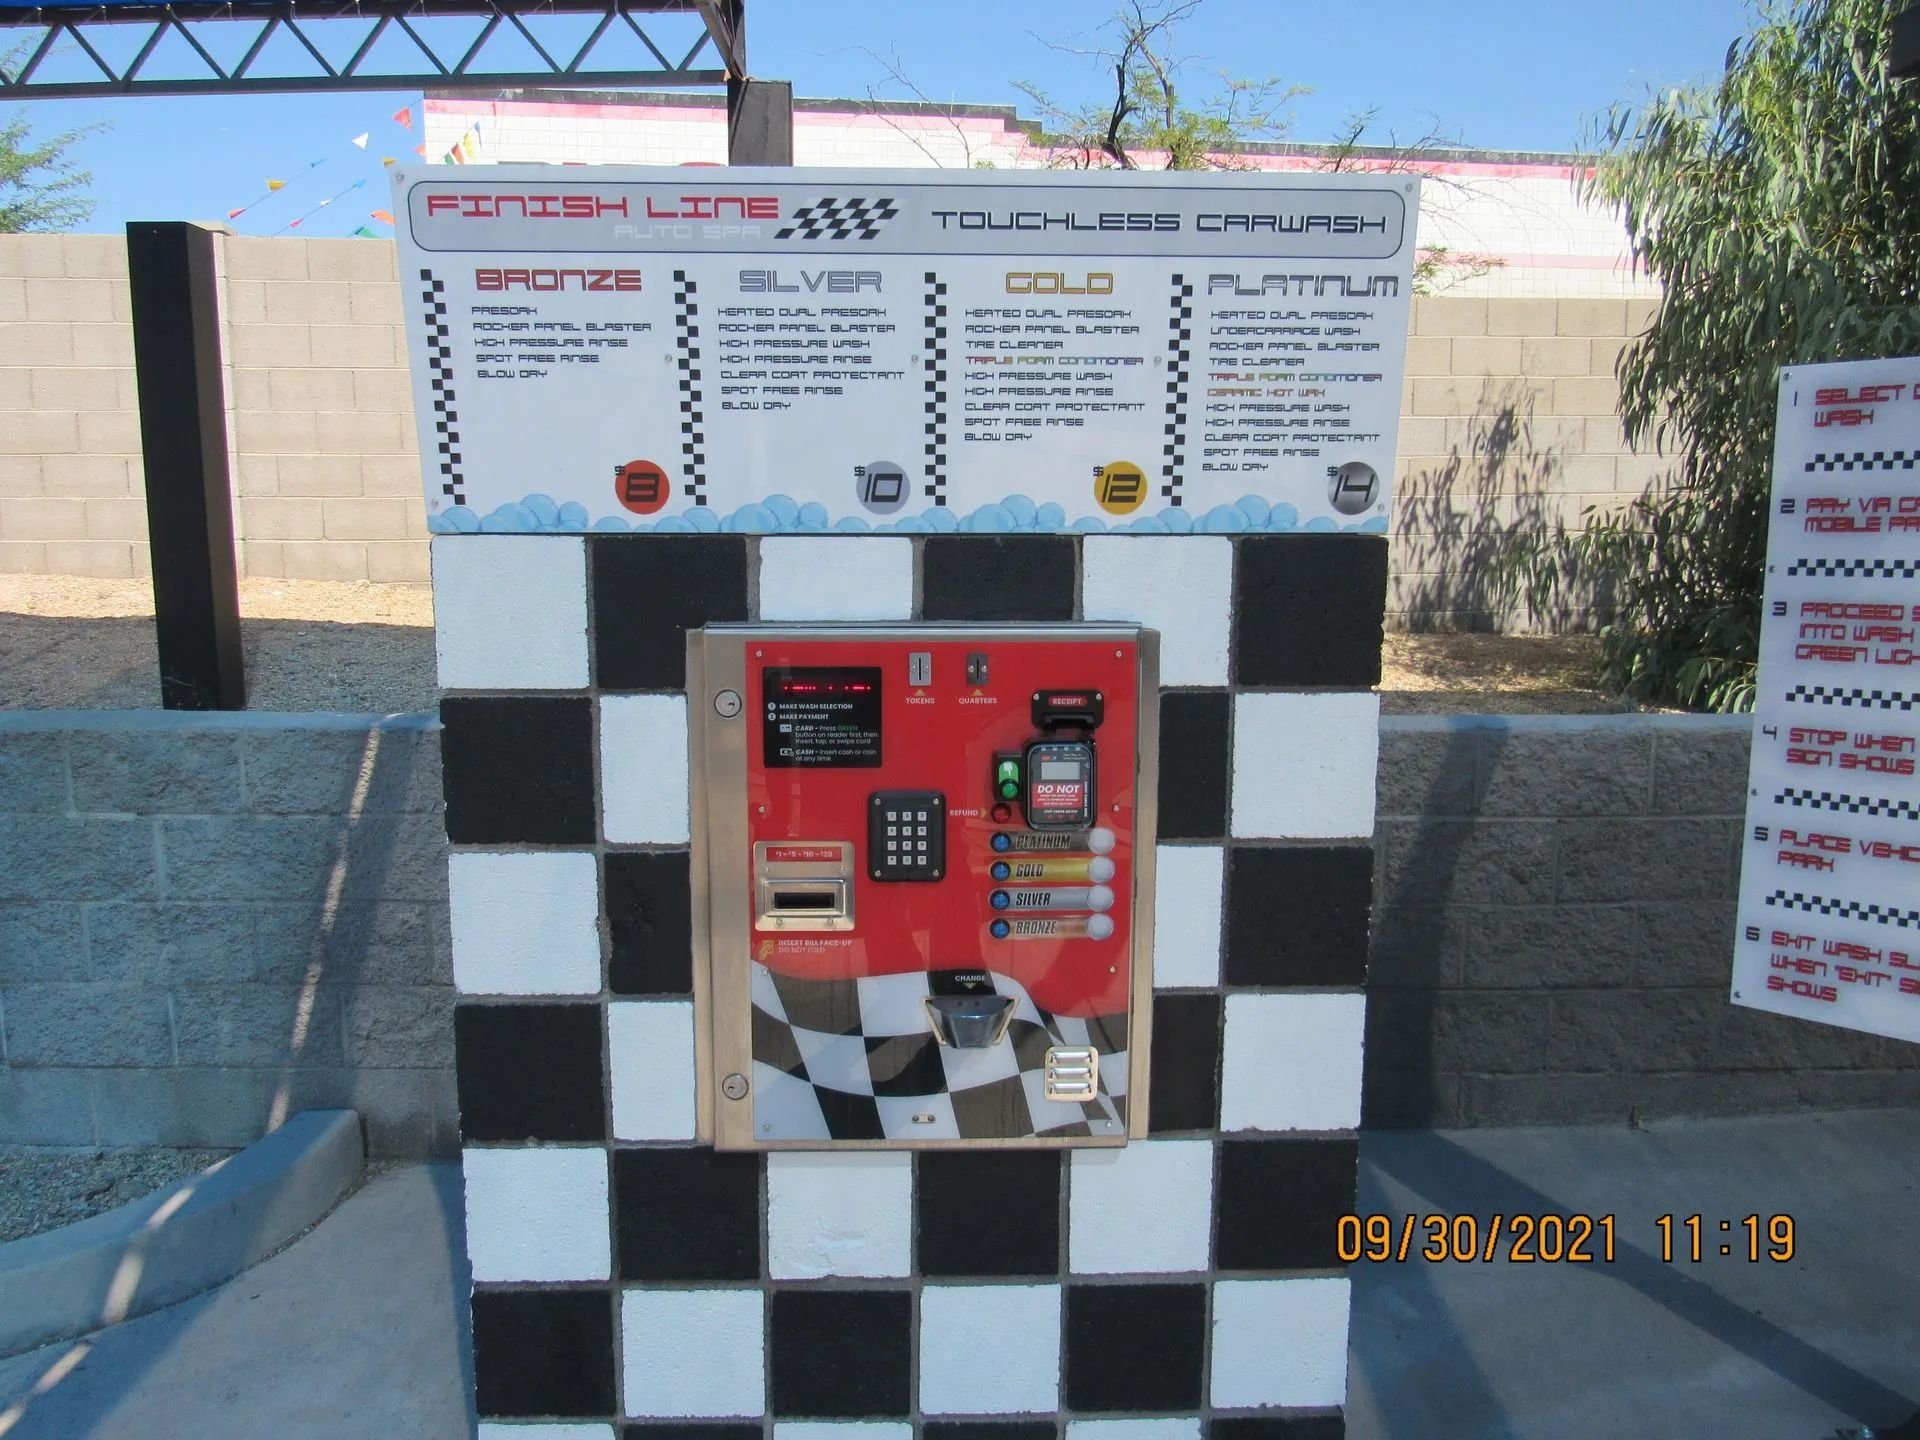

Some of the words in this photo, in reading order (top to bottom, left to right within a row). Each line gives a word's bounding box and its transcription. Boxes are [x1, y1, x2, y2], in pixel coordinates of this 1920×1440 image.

[427, 195, 628, 218] FINISH
[647, 197, 779, 219] LINE
[932, 211, 1180, 231] TOUCHLESS
[1196, 214, 1386, 234] CARWASH
[614, 225, 692, 238] AUTO
[703, 226, 761, 239] SPA
[475, 269, 642, 292] BRONZE
[739, 270, 882, 293] SILVER
[1006, 272, 1113, 294] GOLD
[1208, 274, 1399, 297] PLATINUM
[472, 306, 537, 316] PRESOAK
[718, 307, 774, 317] HEATED
[779, 307, 816, 317] DUAL
[821, 307, 886, 318] PRESOAK
[965, 308, 1021, 319] HEATED
[1026, 308, 1062, 319] DUAL
[1067, 309, 1131, 319] PRESOAK
[1211, 310, 1266, 320] HEATED
[1270, 310, 1306, 321] DUAL
[1311, 311, 1374, 321] PRESOAK
[473, 322, 529, 332] ROCKER
[534, 322, 581, 332] PANEL
[586, 322, 651, 332] BLASTER
[719, 323, 774, 333] ROCKER
[779, 323, 825, 333] PANEL
[831, 323, 895, 333] BLASTER
[965, 324, 1020, 334] ROCKER
[1025, 324, 1071, 334] PANEL
[1076, 325, 1139, 335] BLASTER
[1211, 326, 1320, 336] UNDERCARRIAGE
[1325, 326, 1360, 337] WASH
[474, 338, 505, 348] HIGH
[509, 338, 584, 348] PRESSURE
[589, 338, 628, 348] RINSE
[719, 339, 749, 349] HIGH
[754, 339, 828, 349] PRESSURE
[833, 339, 870, 349] WASH
[965, 340, 995, 350] TIRE
[999, 340, 1063, 350] CLEANER
[1209, 341, 1264, 351] ROCKER
[1268, 342, 1312, 352] PANEL
[1317, 342, 1380, 352] BLASTER
[476, 353, 513, 363] SPOT
[518, 353, 556, 363] FREE
[560, 354, 600, 364] RINSE
[720, 354, 750, 364] HIGH
[754, 354, 828, 364] PRESSURE
[833, 355, 872, 365] RINSE
[965, 355, 1013, 365] TRIPLE
[1017, 355, 1054, 366] FOAM
[1059, 356, 1144, 366] CONDITIONER
[1209, 357, 1237, 367] TIRE
[1242, 357, 1305, 367] CLEANER
[477, 369, 515, 379] BLOW
[519, 369, 547, 379] DRY
[721, 370, 767, 380] CLEAR
[772, 370, 808, 380] COAT
[813, 370, 905, 380] PROTECTANT
[965, 371, 994, 381] HIGH
[999, 371, 1071, 381] PRESSURE
[1076, 371, 1112, 381] WASH
[721, 385, 758, 395] SPOT
[763, 385, 800, 395] FREE
[804, 386, 843, 396] RINSE
[965, 386, 994, 396] HIGH
[999, 387, 1071, 397] PRESSURE
[1076, 387, 1113, 397] RINSE
[1815, 384, 1906, 406] SELECT
[722, 401, 759, 411] BLOW
[763, 401, 791, 411] DRY
[965, 402, 1010, 412] CLEAR
[1015, 402, 1051, 412] COAT
[1056, 402, 1145, 412] PROTECTANT
[1206, 403, 1235, 412] HIGH
[1239, 403, 1310, 413] PRESSURE
[1314, 403, 1350, 413] WASH
[965, 417, 1001, 427] SPOT
[1005, 417, 1041, 427] FREE
[1046, 417, 1084, 427] RINSE
[1205, 417, 1234, 427] HIGH
[1238, 418, 1309, 428] PRESSURE
[1313, 418, 1350, 428] RINSE
[1813, 409, 1874, 428] WASH
[965, 432, 1001, 442] BLOW
[1005, 432, 1032, 442] DRY
[1205, 433, 1249, 442] CLEAR
[1253, 433, 1288, 443] COAT
[1293, 433, 1380, 443] PROTECTANT
[1204, 447, 1239, 457] SPOT
[1243, 448, 1278, 457] FREE
[1283, 448, 1320, 457] RINSE
[1202, 462, 1238, 472] BLOW
[1242, 462, 1268, 472] DRY
[1780, 498, 1795, 514] 2
[1805, 497, 1850, 513] PAY
[1858, 497, 1891, 513] VIA
[1804, 515, 1881, 533] MOBILE
[1772, 601, 1787, 616] 3
[1800, 602, 1904, 621] PROCEED
[1799, 623, 1846, 641] INTO
[1853, 625, 1914, 643] WASH
[1795, 644, 1868, 663] GREEN
[906, 697, 935, 705] TOKENS
[959, 697, 997, 705] QUARTERS
[1052, 697, 1082, 706] RECEIPT
[1789, 727, 1847, 747] STOP
[1854, 733, 1915, 754] WHEN
[1786, 748, 1832, 767] SIGN
[1839, 753, 1914, 776] SHOWS
[1037, 784, 1054, 794] DO
[1056, 784, 1080, 794] NOT
[1016, 835, 1071, 848] PLATINUM
[1754, 826, 1769, 842] 5
[1779, 829, 1851, 854] PLACE
[1777, 851, 1835, 873] PARK
[1016, 864, 1043, 877] GOLD
[1016, 892, 1051, 906] SILVER
[1016, 921, 1056, 934] BRONZE
[1745, 926, 1760, 942] 6
[1771, 930, 1816, 951] EXIT
[1823, 939, 1882, 964] WASH
[1770, 953, 1827, 977] WHEN
[954, 975, 986, 983] CHANGE
[1767, 976, 1837, 1003] SHOWS
